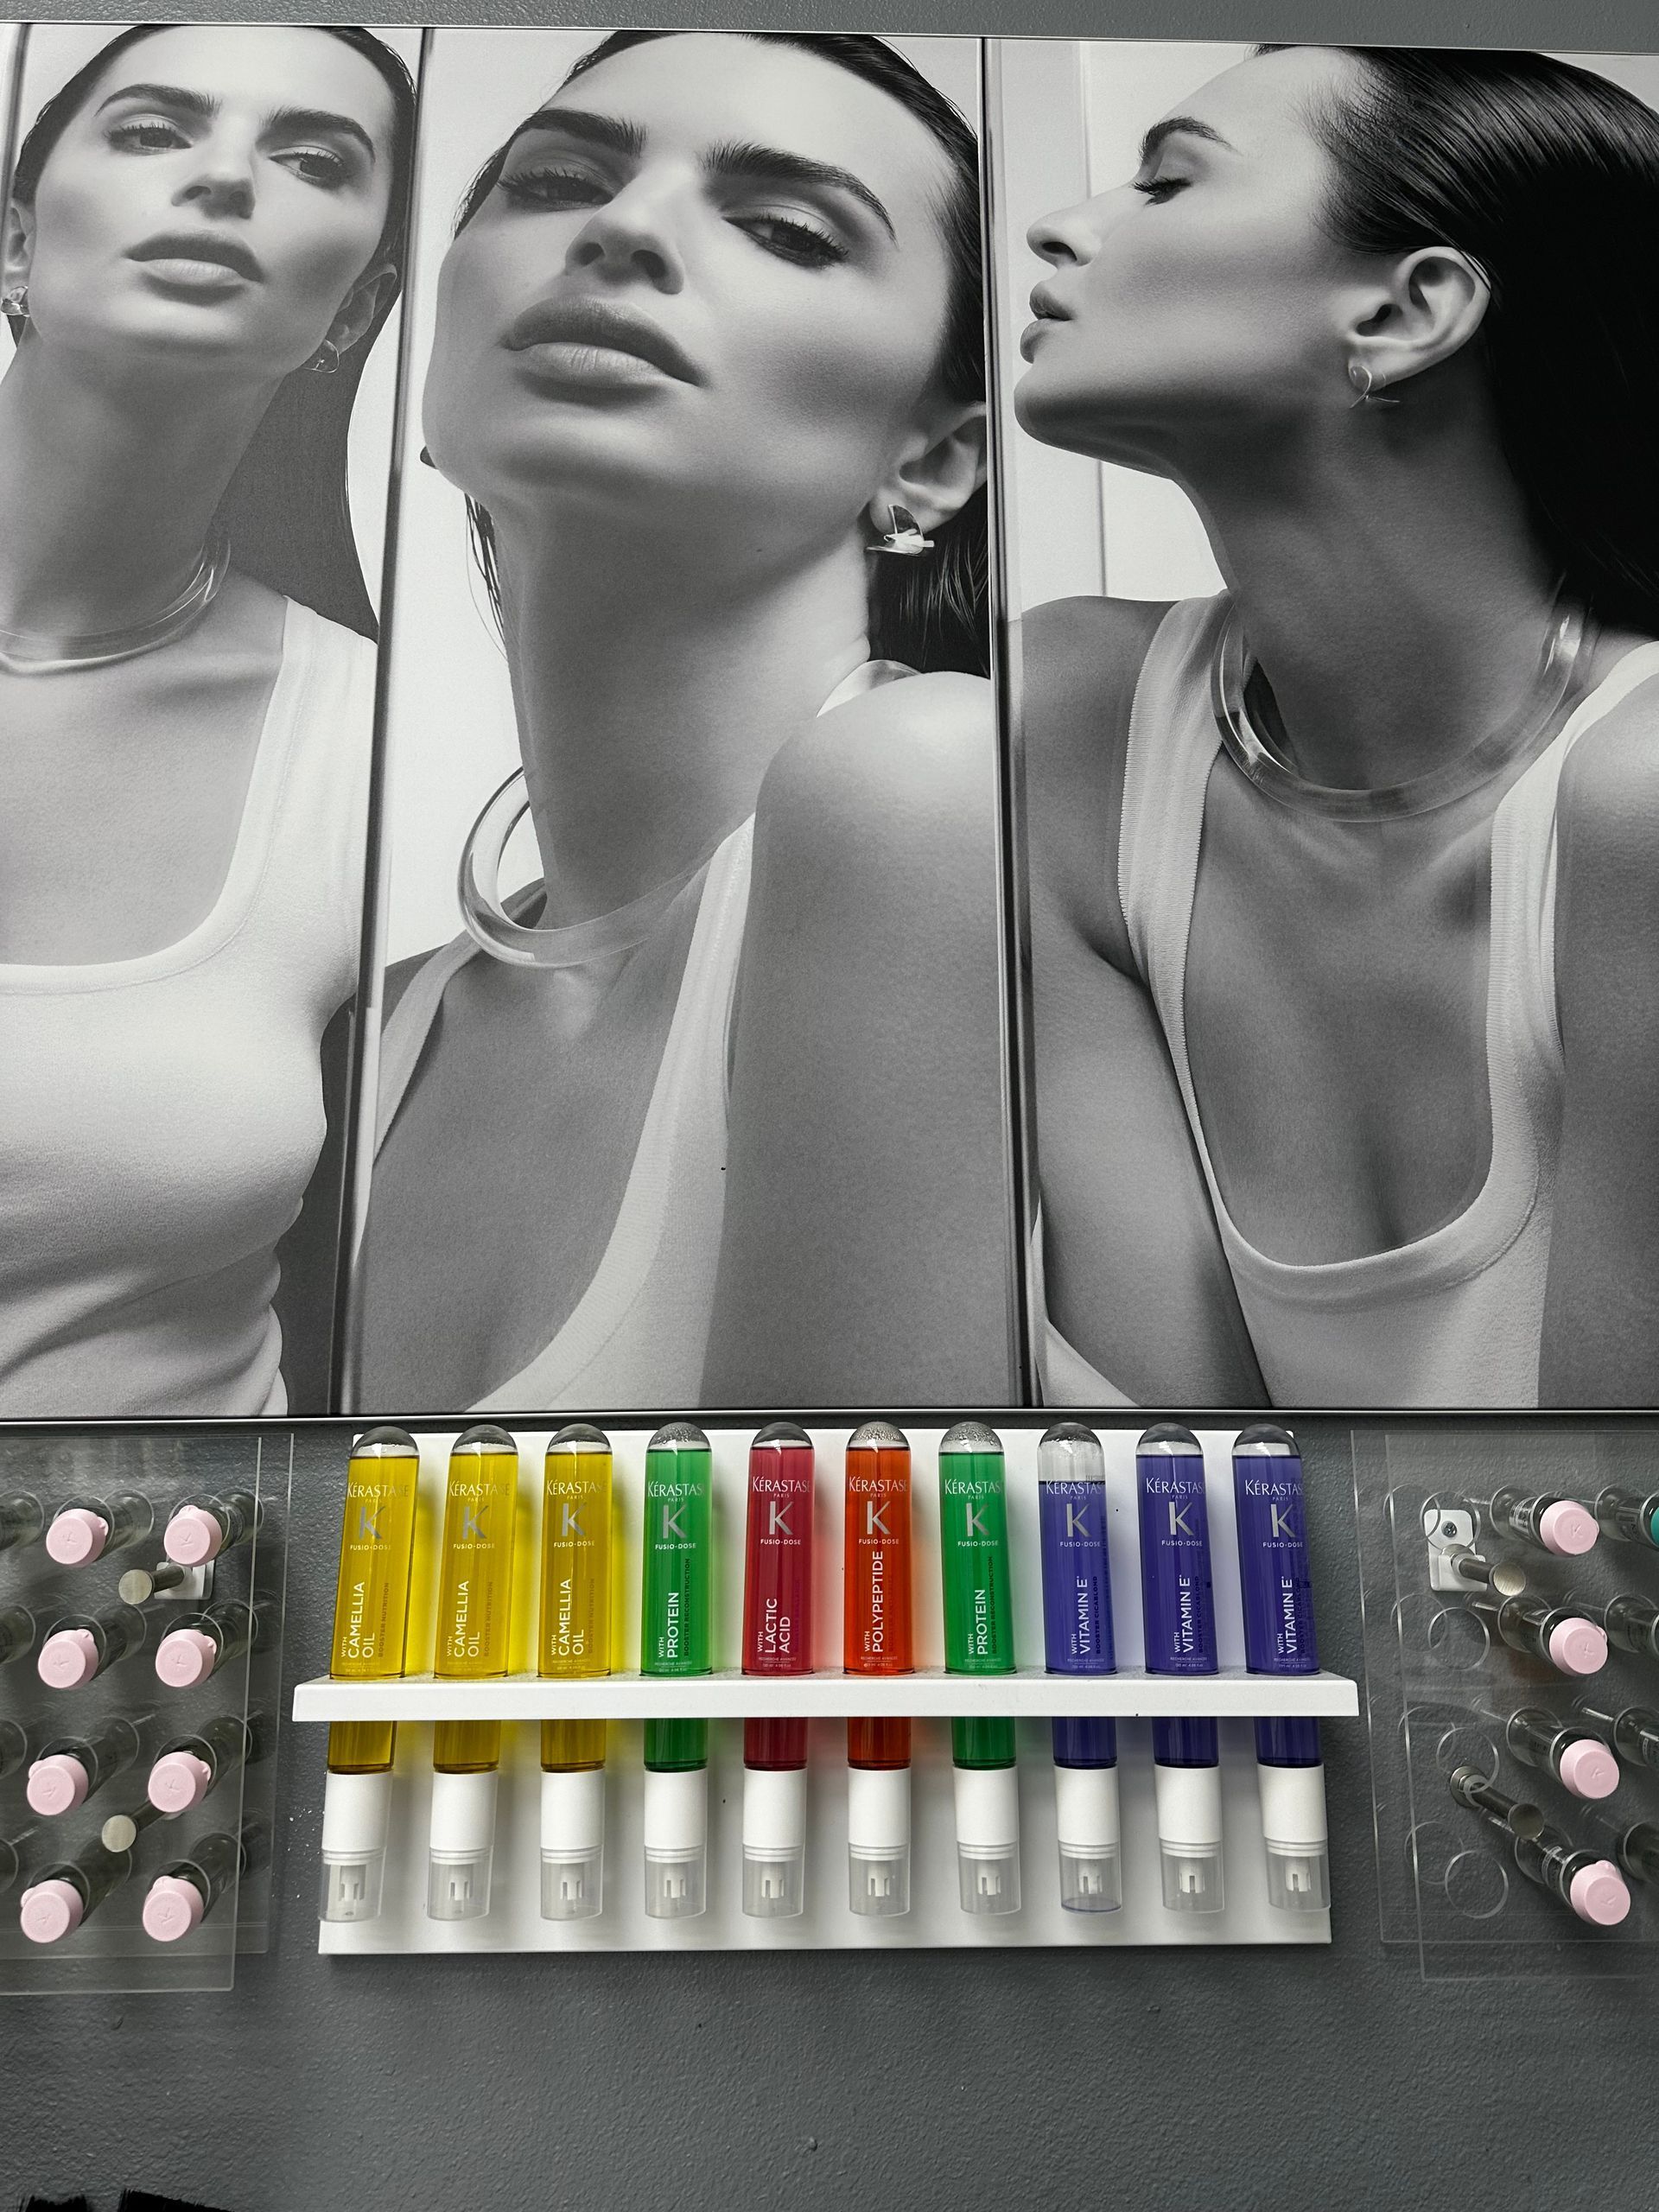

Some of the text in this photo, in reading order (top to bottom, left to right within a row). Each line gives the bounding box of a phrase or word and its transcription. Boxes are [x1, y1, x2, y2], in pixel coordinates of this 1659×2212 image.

[648, 1481, 703, 1497] KÉRASTAS
[944, 1478, 1001, 1494] KÉRASTAS
[1146, 1478, 1203, 1493] KÉRASTAS
[359, 1506, 386, 1540] K
[463, 1505, 489, 1540] K
[562, 1502, 587, 1537] K
[663, 1504, 687, 1539] K
[769, 1501, 793, 1535] K
[867, 1501, 891, 1535] K
[966, 1503, 989, 1537] K
[1066, 1503, 1091, 1537] K
[1169, 1501, 1194, 1535] K
[1270, 1503, 1295, 1538] K
[348, 1581, 365, 1658] CAMELLIA
[454, 1580, 469, 1657] CAMELLIA
[558, 1579, 571, 1656] CAMELLIA
[872, 1551, 883, 1653] POLYPEPTIDE
[667, 1592, 679, 1658] PROTEIN
[765, 1599, 778, 1653] LACTIC
[779, 1617, 791, 1654] ACID
[975, 1589, 988, 1655] PROTEIN
[1077, 1592, 1090, 1654] VITAMIN
[1179, 1592, 1193, 1653] VITAMIN
[1282, 1592, 1297, 1654] VITAMIN
[362, 1632, 375, 1658] OIL
[467, 1631, 480, 1657] OIL
[572, 1630, 584, 1655] OIL
